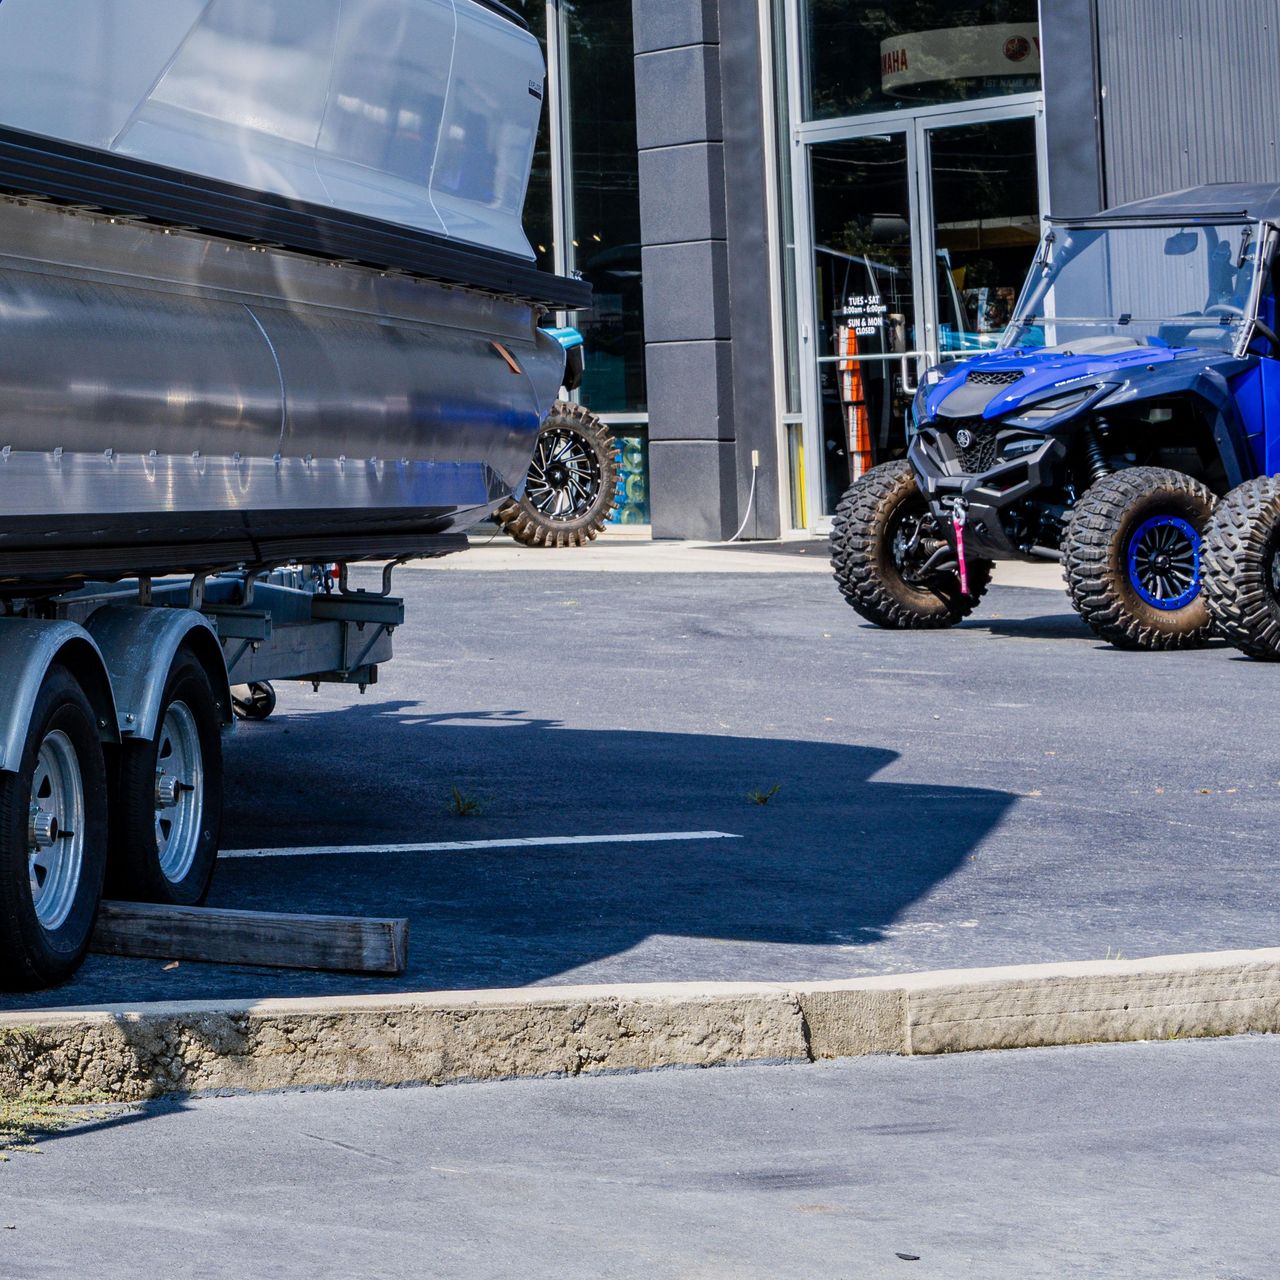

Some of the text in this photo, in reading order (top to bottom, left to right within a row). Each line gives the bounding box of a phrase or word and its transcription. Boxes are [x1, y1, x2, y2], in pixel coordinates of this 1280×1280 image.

[848, 296, 880, 305] TUES SAT
[848, 318, 861, 328] SUN
[867, 317, 883, 327] MON
[856, 327, 875, 335] CLOSED
